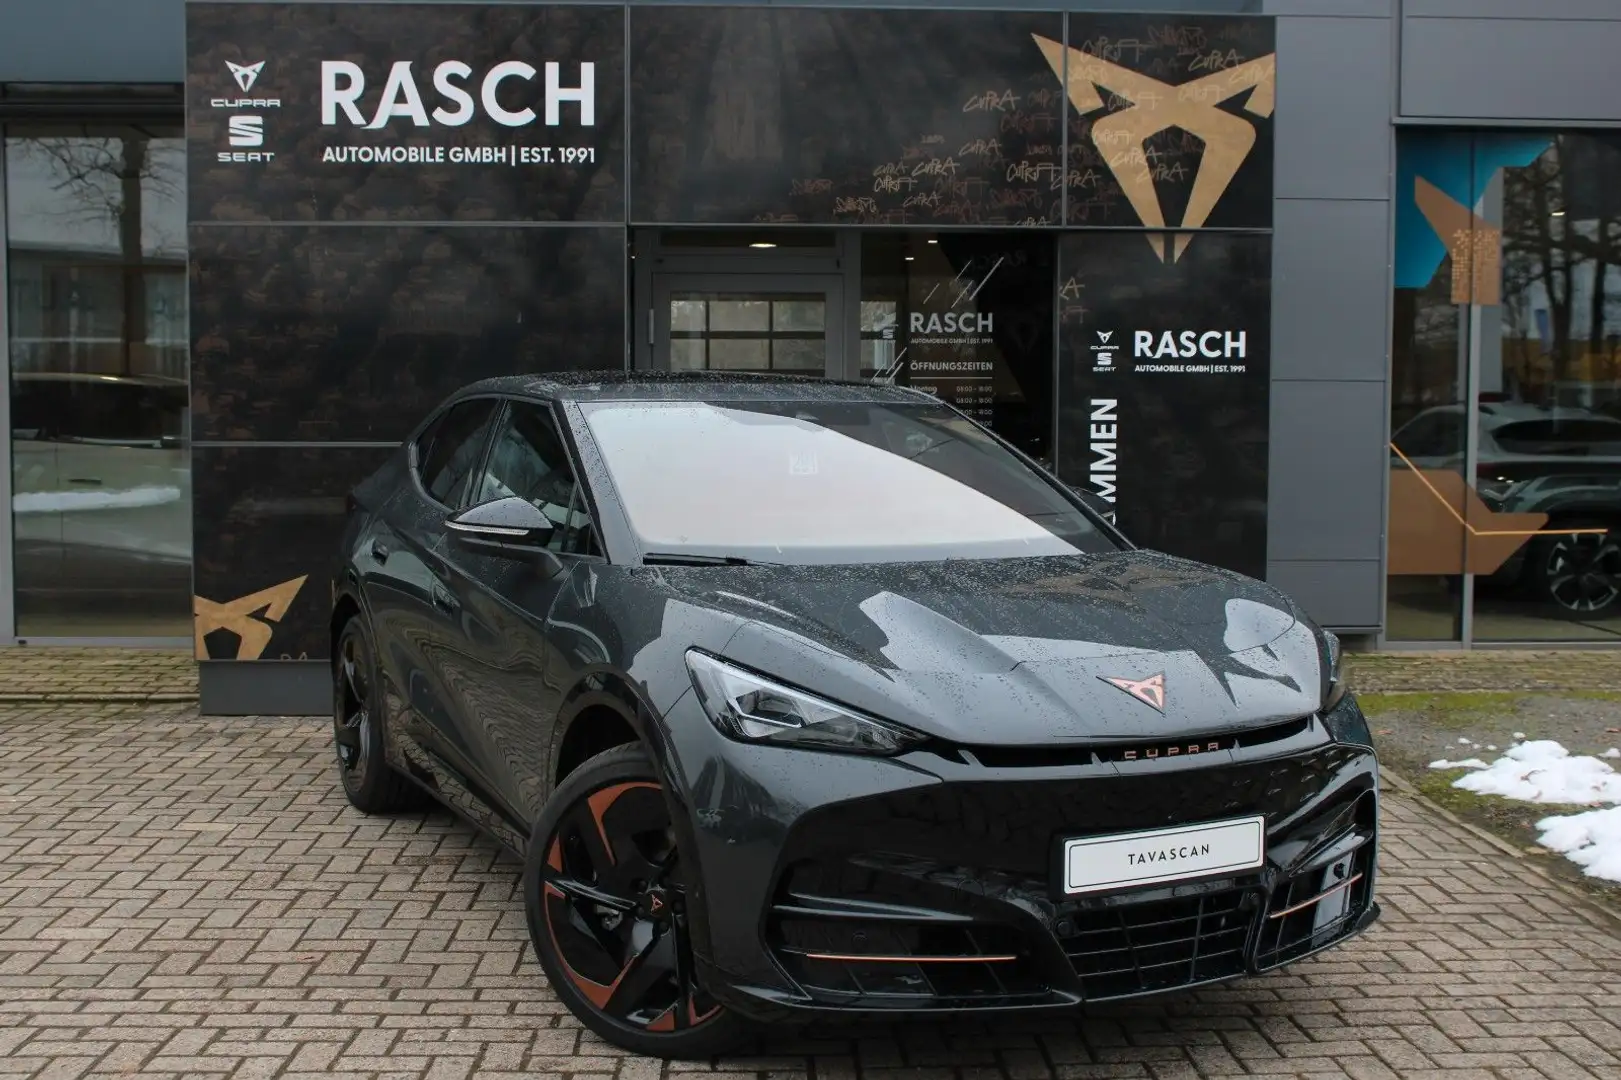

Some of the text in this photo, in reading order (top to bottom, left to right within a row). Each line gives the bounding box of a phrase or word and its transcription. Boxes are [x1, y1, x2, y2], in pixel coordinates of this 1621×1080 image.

[211, 98, 281, 108] CUPRA
[321, 60, 595, 129] RASCH
[962, 88, 1021, 113] CUPRA
[217, 152, 275, 162] SEAT
[322, 146, 444, 164] AUTOMOBILE
[449, 146, 506, 164] GMBH
[520, 146, 555, 164] EST.
[560, 146, 595, 164] 1991
[910, 311, 993, 334] RASCH
[1134, 330, 1246, 358] RASCH
[910, 360, 993, 370] ÖFFNUNGSZEITEN
[1089, 399, 1117, 526] MMEN
[1124, 742, 1219, 760] CUPRA
[1128, 844, 1209, 866] TAVASCAN
